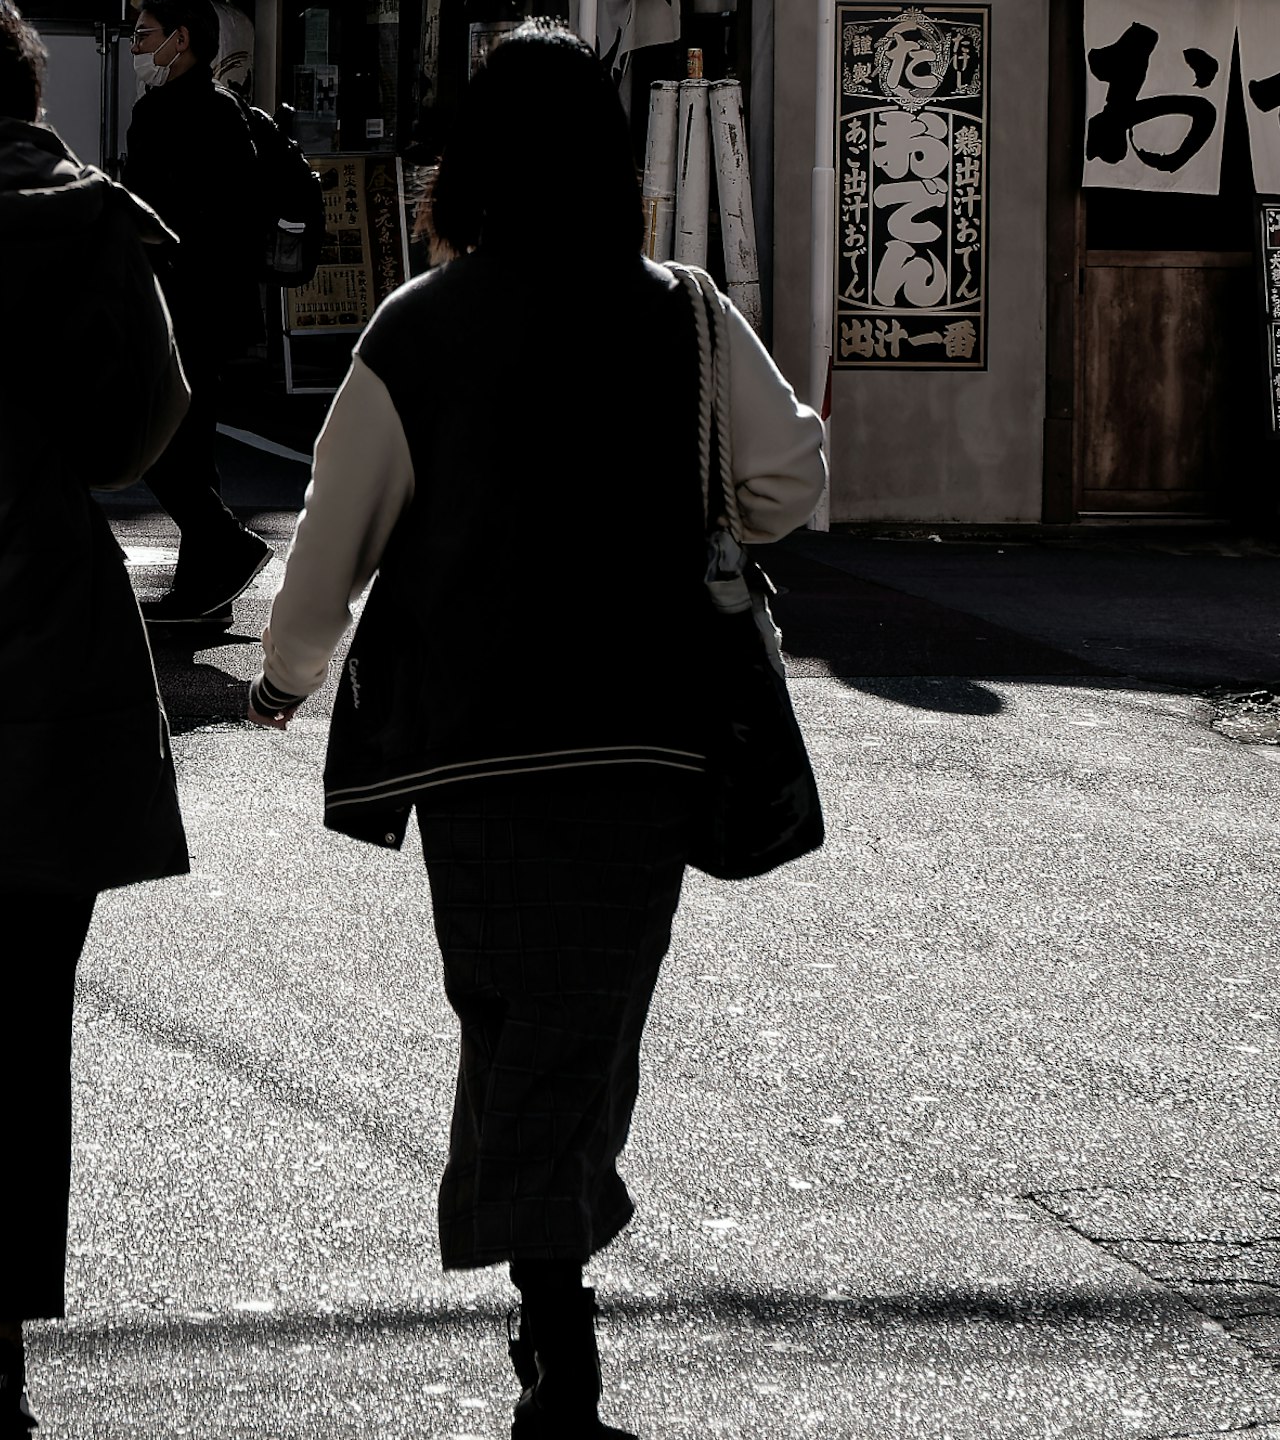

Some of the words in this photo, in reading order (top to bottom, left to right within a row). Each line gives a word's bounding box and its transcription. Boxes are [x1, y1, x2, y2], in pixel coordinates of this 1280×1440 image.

[885, 31, 940, 90] た
[950, 31, 971, 94] たけし
[842, 117, 870, 299] あご出汁おでん
[871, 110, 950, 308] おでん
[953, 124, 983, 299] 鶏出汁おでん
[839, 317, 977, 361] 出汁一番
